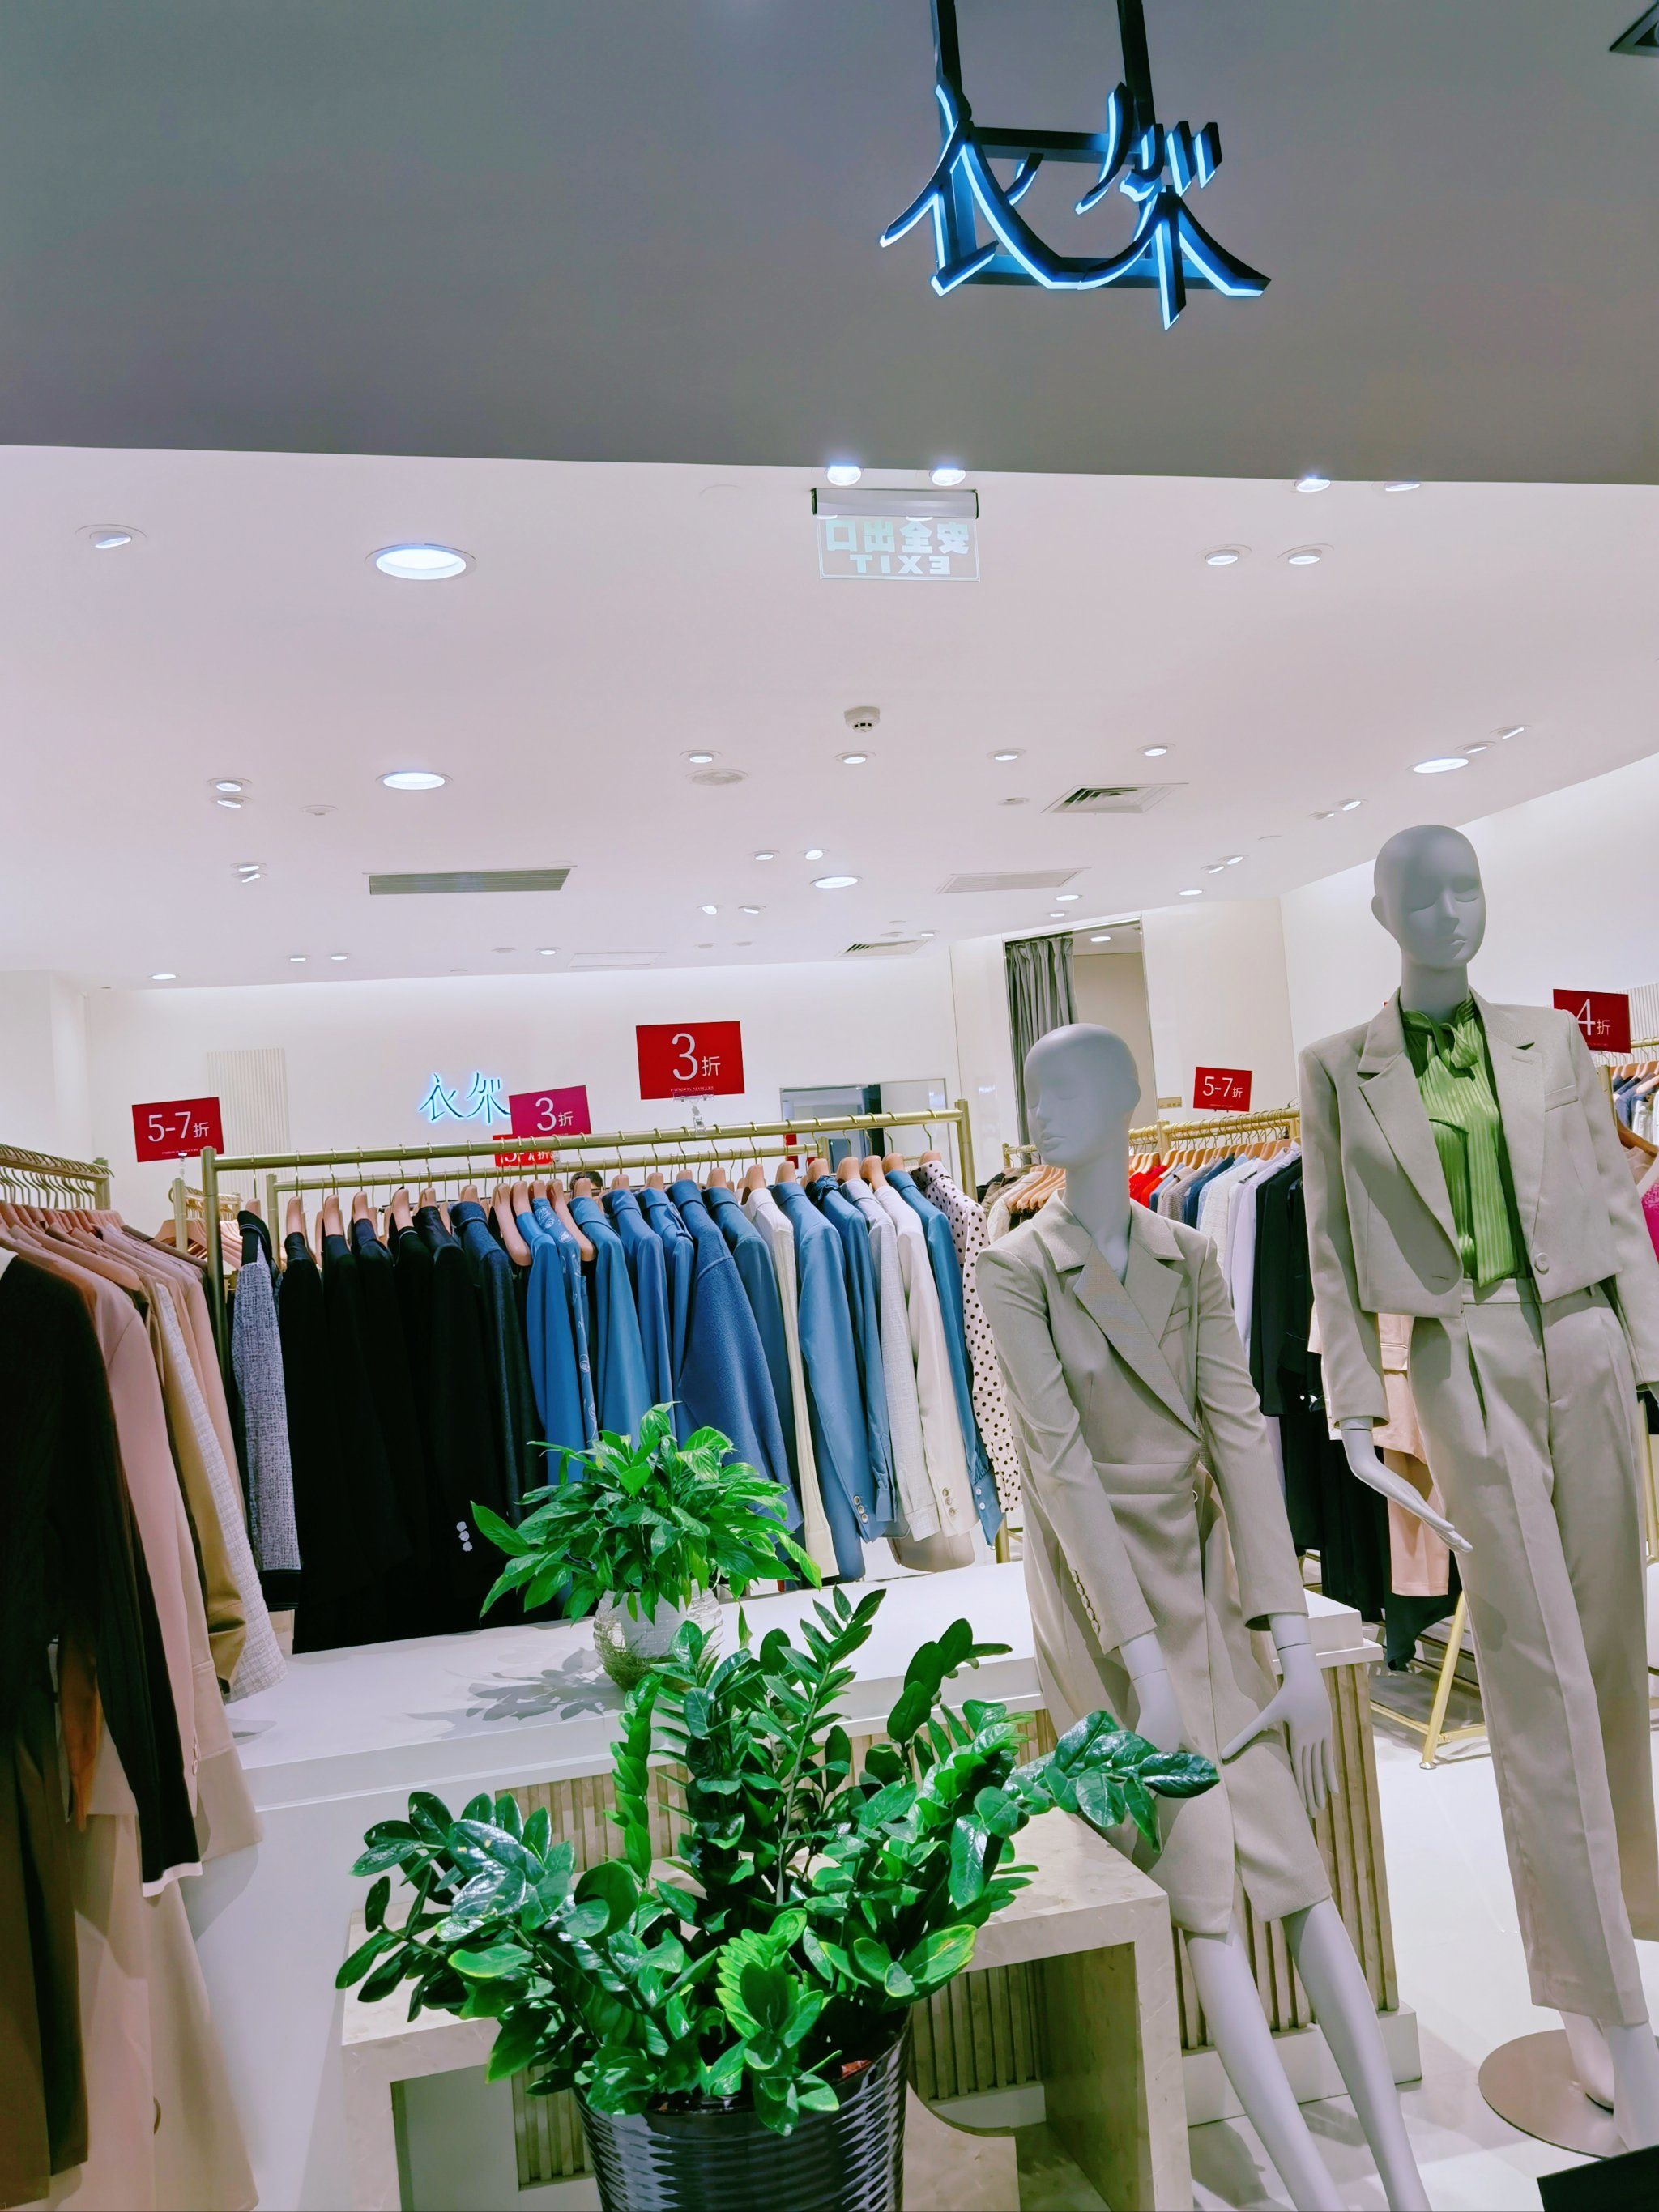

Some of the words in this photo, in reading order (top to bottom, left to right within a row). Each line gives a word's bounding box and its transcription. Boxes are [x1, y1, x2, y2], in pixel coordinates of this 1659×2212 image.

[880, 83, 1272, 330] 衣架
[1576, 999, 1611, 1036] 4折
[672, 1033, 721, 1080] 3折
[418, 1072, 511, 1124] 衣架
[1202, 1076, 1243, 1098] 5-7折
[148, 1111, 210, 1142] 5-7折
[535, 1097, 574, 1132] 3折
